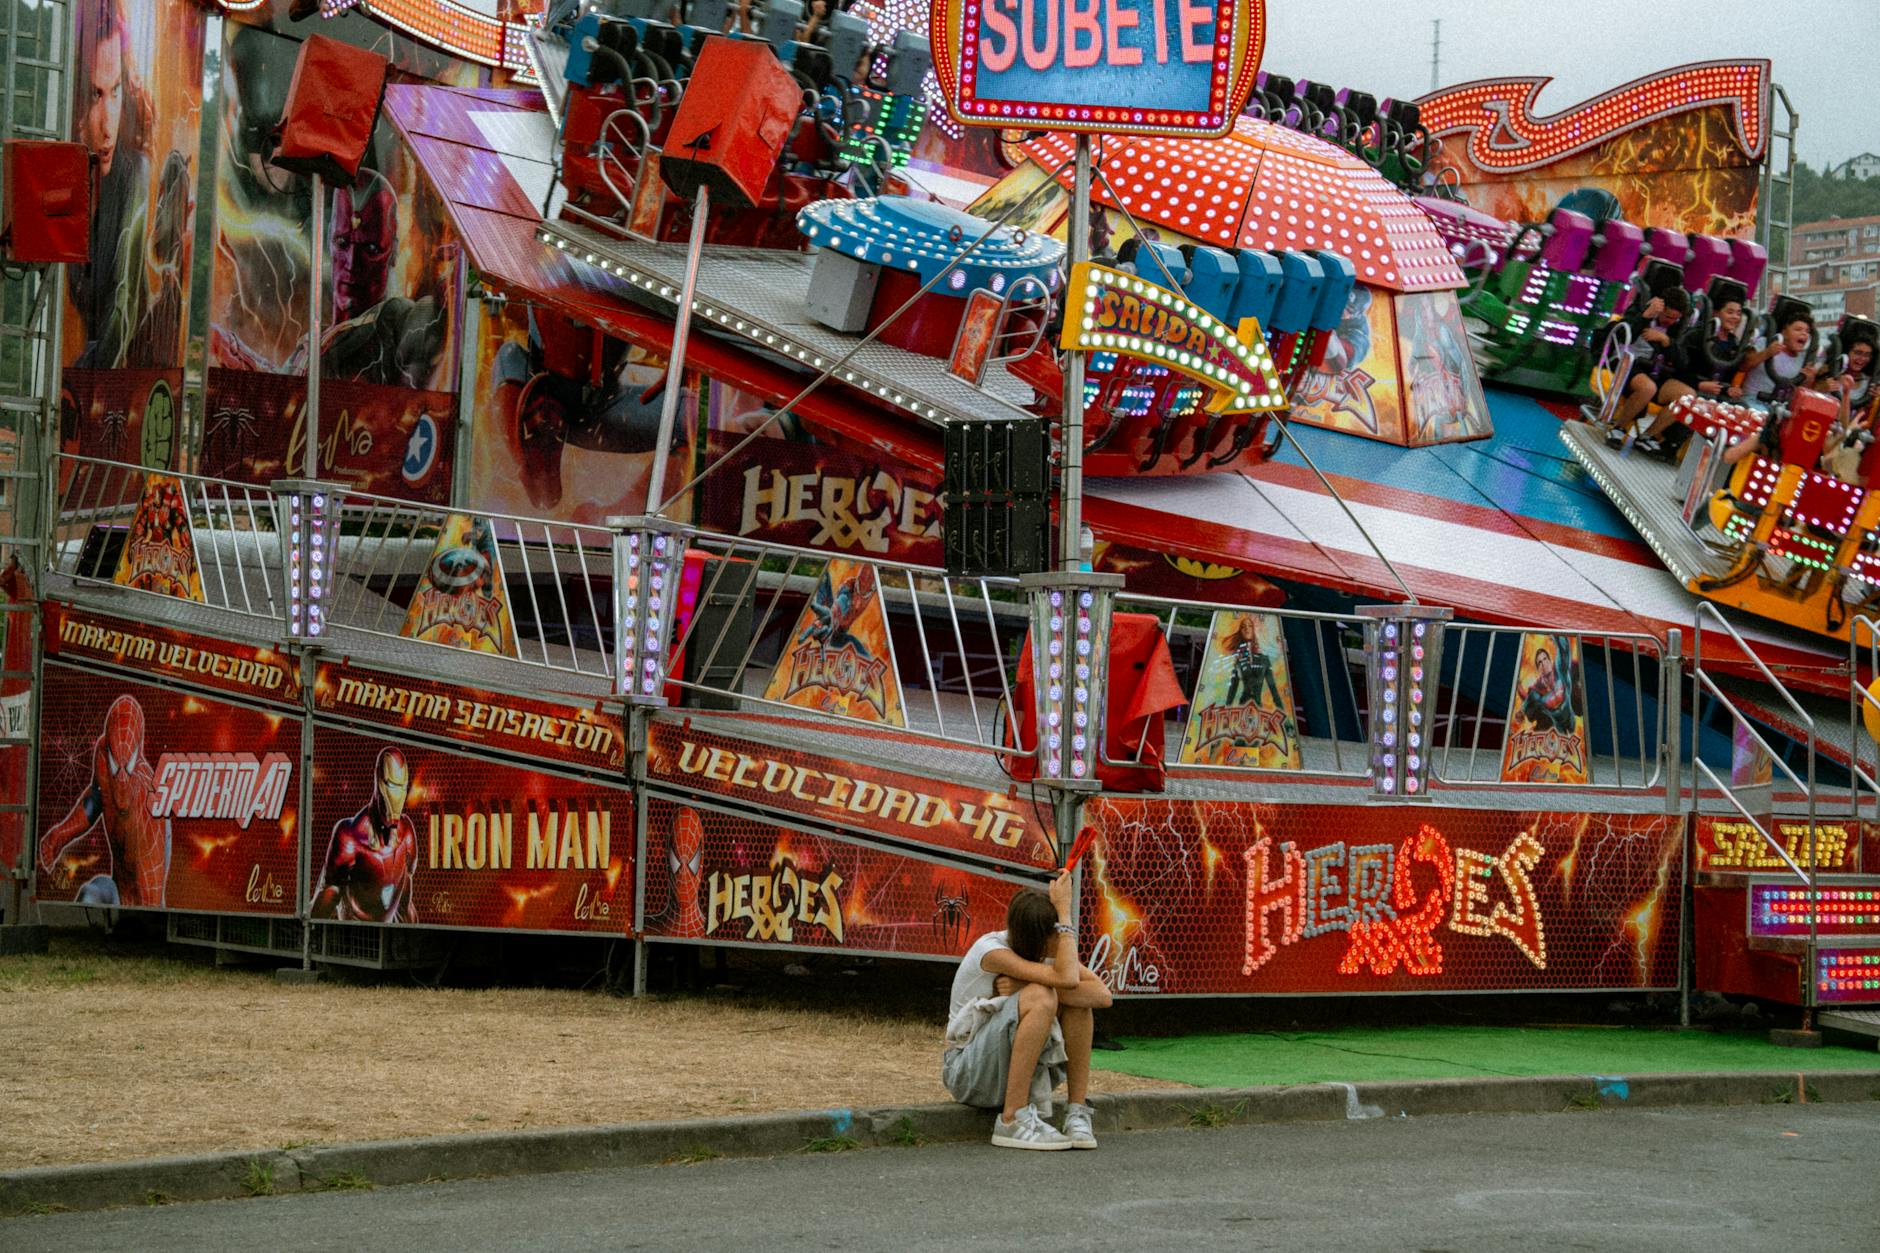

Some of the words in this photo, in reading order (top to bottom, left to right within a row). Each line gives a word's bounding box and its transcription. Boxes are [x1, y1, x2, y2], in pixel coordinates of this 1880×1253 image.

[1099, 290, 1207, 356] SALIDA
[416, 587, 503, 653] HEROES
[158, 641, 284, 689] VELOCIDAD
[783, 641, 887, 719] HEROES
[1194, 699, 1288, 757] HEROES
[1508, 727, 1582, 774] HEROES
[149, 753, 293, 830] SPIDERMAN
[678, 741, 949, 829] VELOCIDAD
[959, 801, 1026, 848] 4G
[429, 812, 513, 870] IRON
[526, 811, 611, 870] MAN
[1709, 822, 1849, 868] SALIDA
[706, 864, 844, 944] HEROES
[1242, 823, 1547, 975] HEROES
